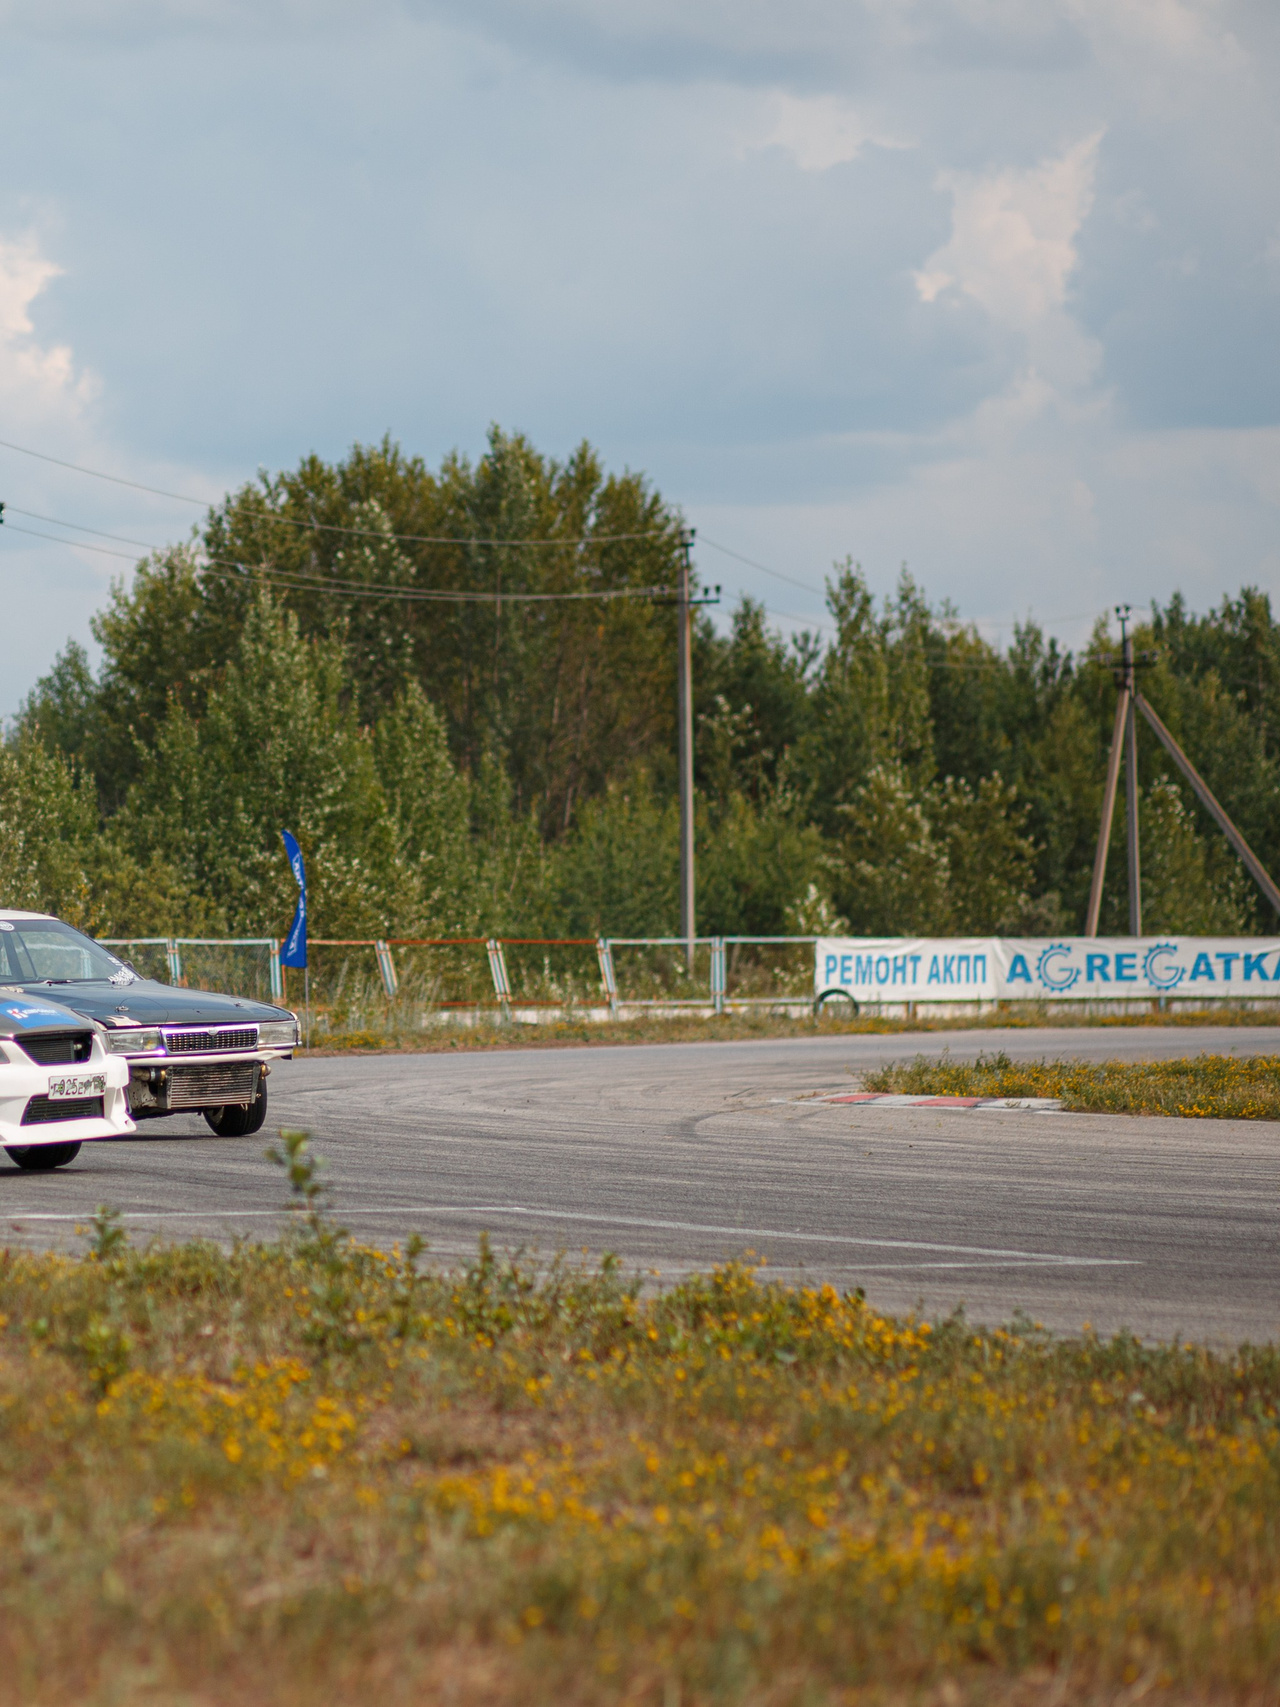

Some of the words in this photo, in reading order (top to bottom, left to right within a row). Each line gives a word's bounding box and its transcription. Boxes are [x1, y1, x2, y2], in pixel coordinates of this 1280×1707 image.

[825, 954, 920, 985] РЕМОНТ
[927, 954, 987, 985] АКПП
[1006, 943, 1280, 993] AGREGATK
